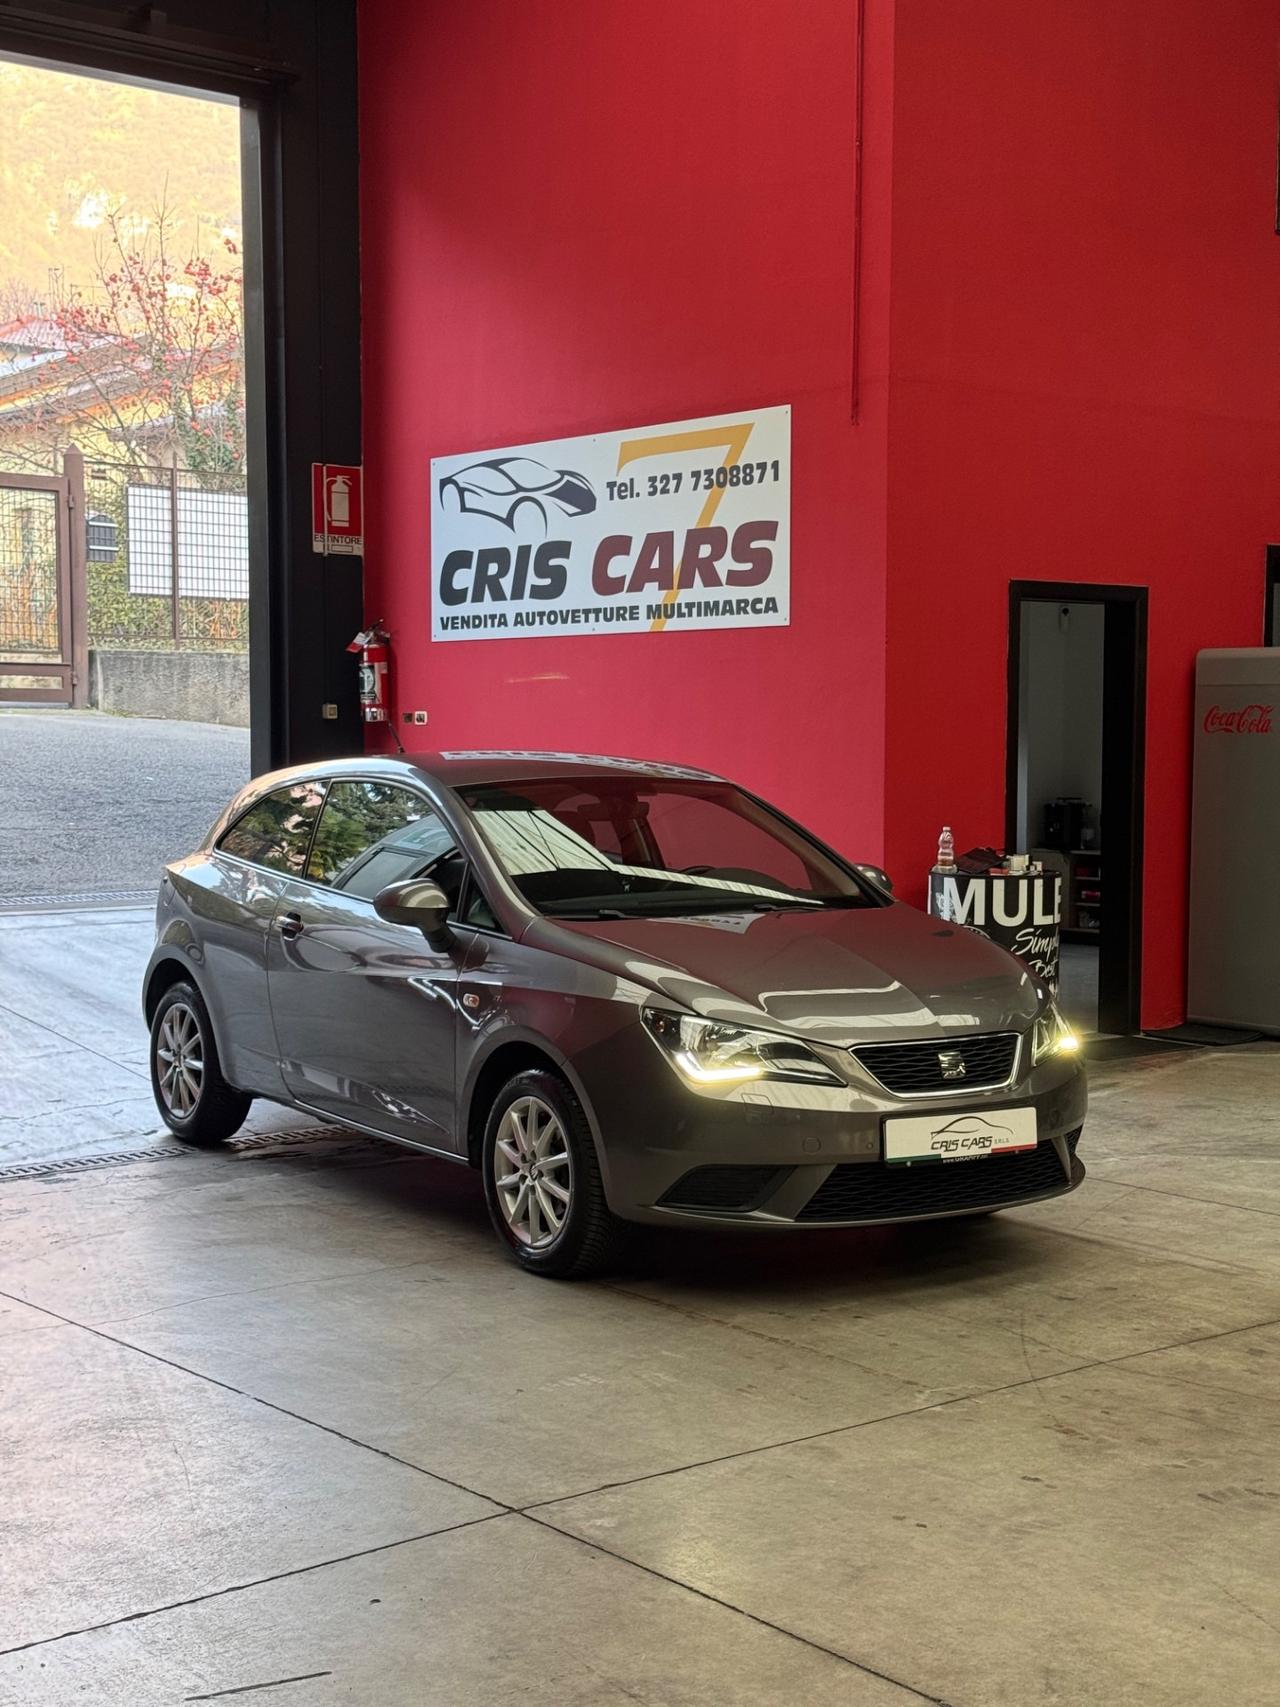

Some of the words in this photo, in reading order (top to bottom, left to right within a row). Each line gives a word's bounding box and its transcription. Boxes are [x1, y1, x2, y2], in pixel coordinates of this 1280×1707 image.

[606, 478, 640, 501] Tel.
[647, 472, 683, 497] 327
[691, 460, 780, 491] 7308871
[439, 540, 572, 607] CRIS
[591, 520, 779, 597] CARS
[440, 612, 508, 631] VENDITA
[513, 605, 640, 627] AUTOVETTURE
[646, 596, 779, 620] MULTIMARCA
[931, 1139, 960, 1152] CRIS
[961, 1136, 993, 1150] CARS
